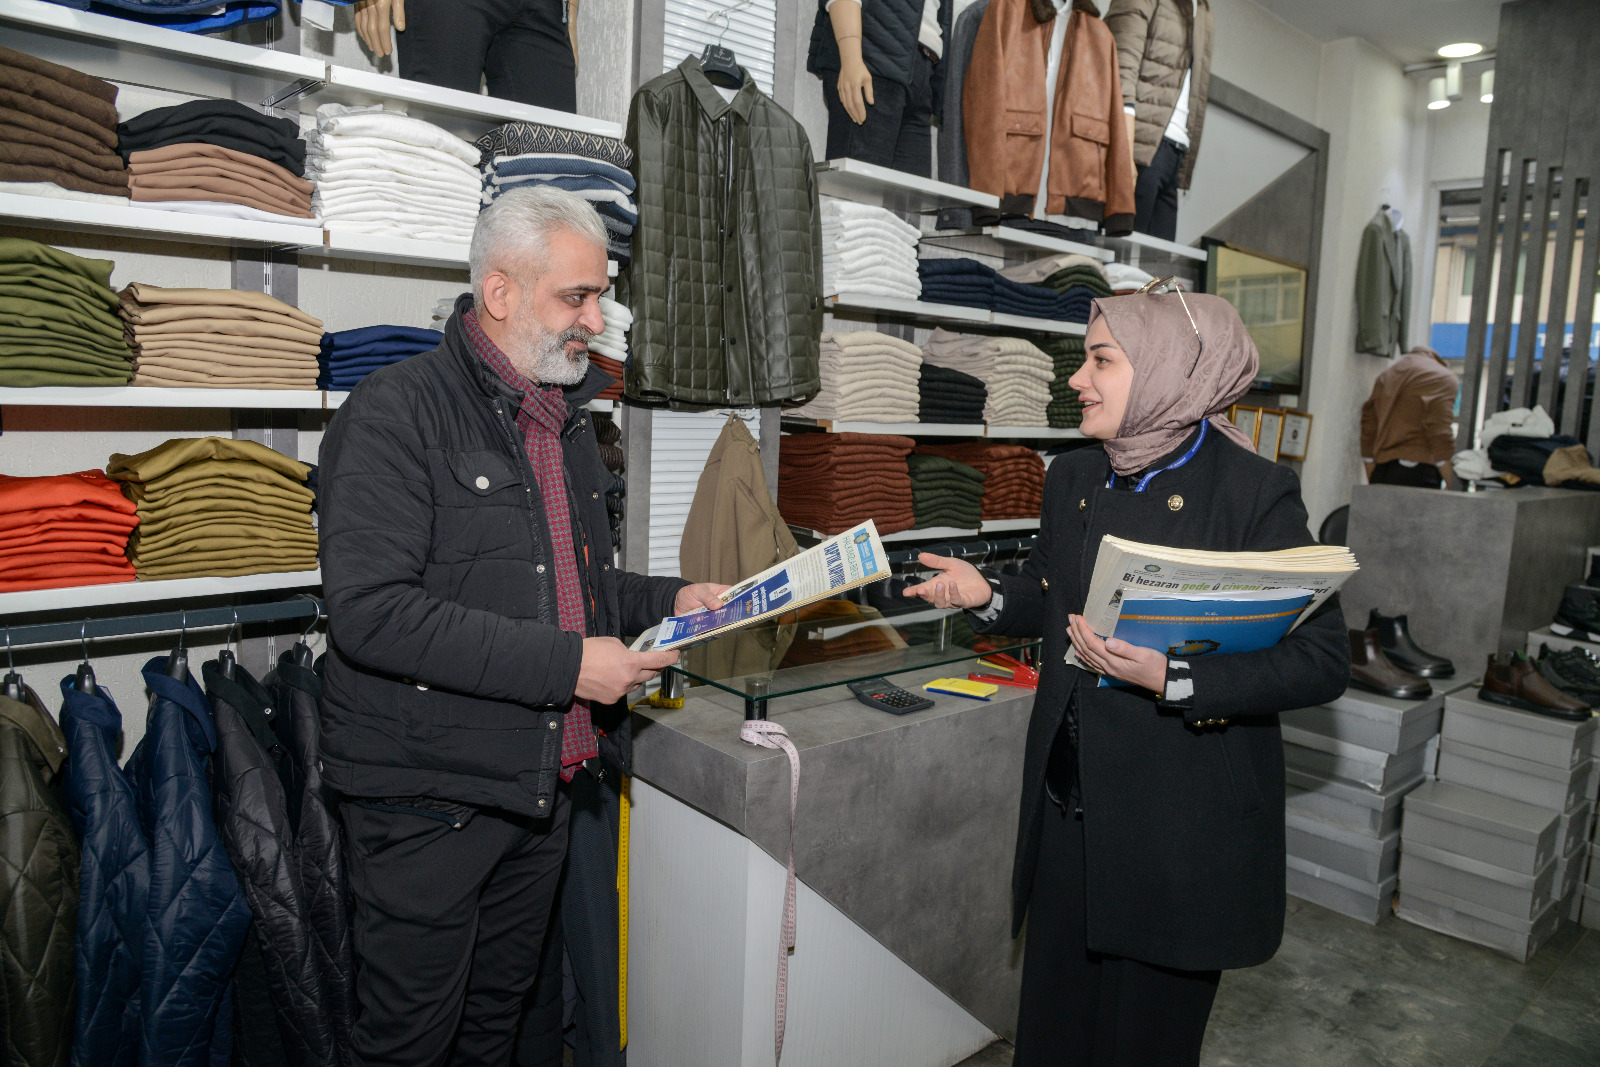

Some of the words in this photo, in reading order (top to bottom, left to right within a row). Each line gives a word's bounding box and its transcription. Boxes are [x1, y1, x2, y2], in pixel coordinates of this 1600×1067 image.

[1122, 573, 1136, 583] Bi
[1136, 575, 1180, 589] hezaran
[1181, 582, 1211, 592] gede
